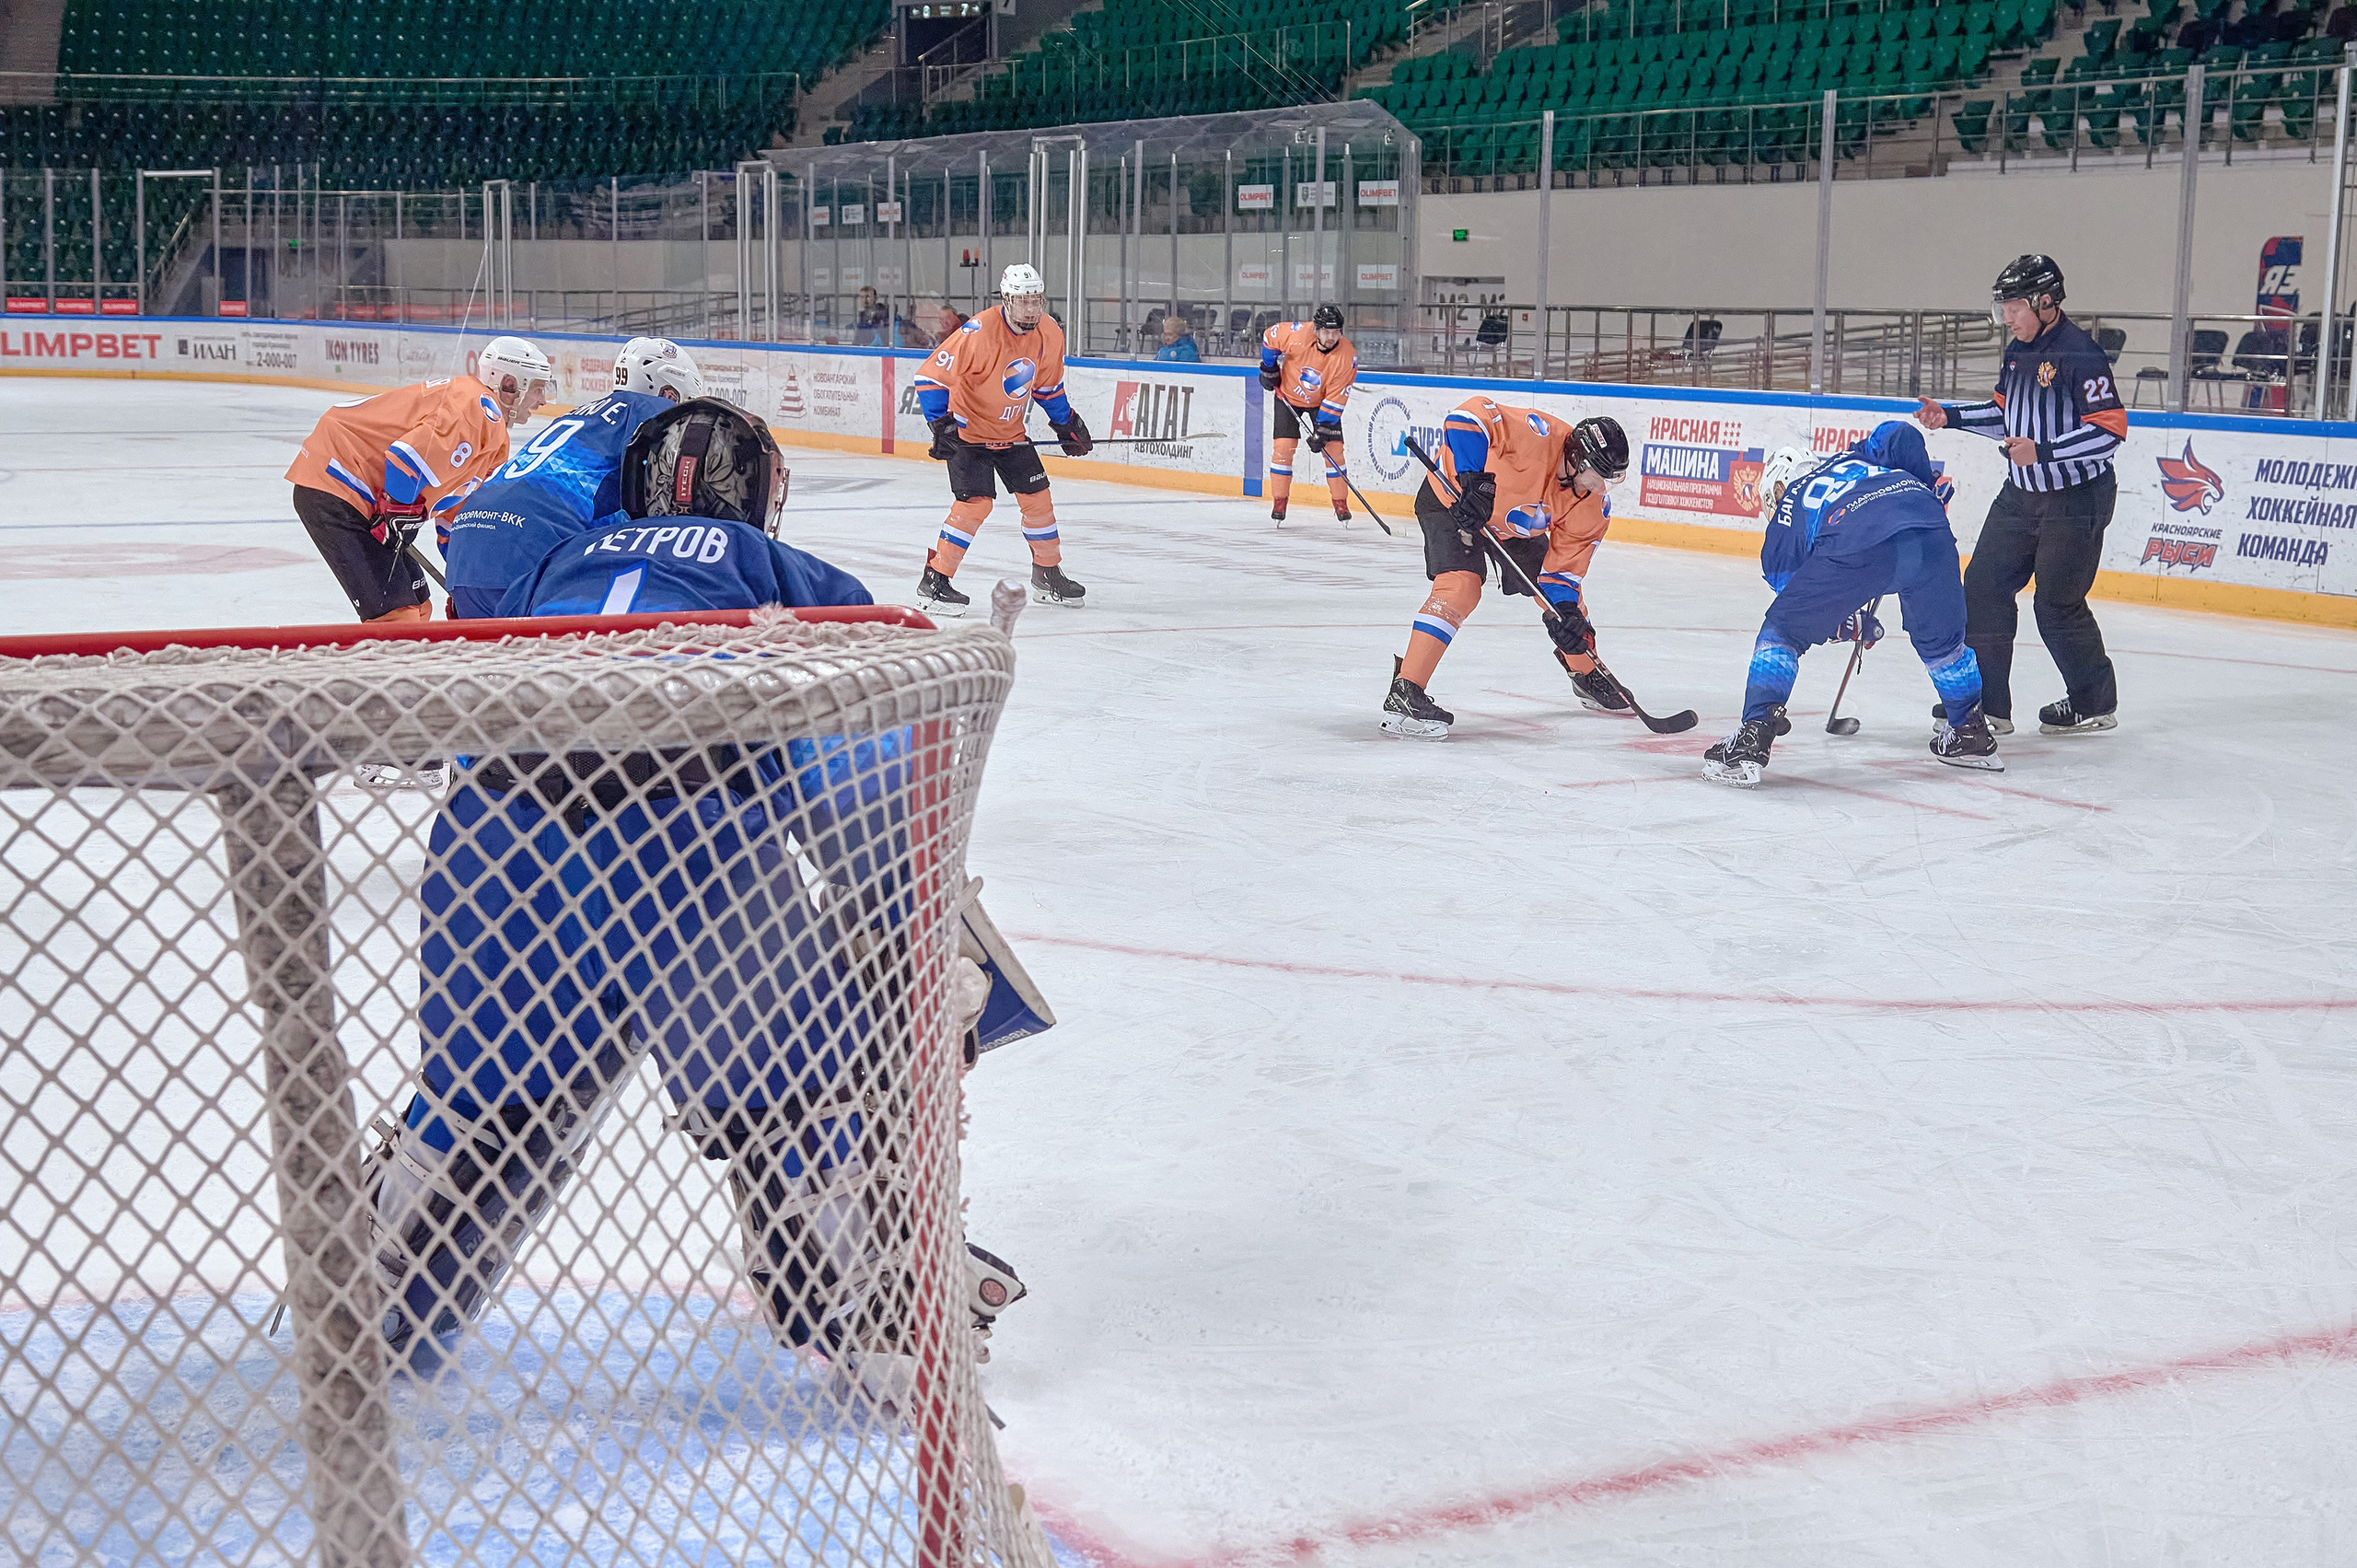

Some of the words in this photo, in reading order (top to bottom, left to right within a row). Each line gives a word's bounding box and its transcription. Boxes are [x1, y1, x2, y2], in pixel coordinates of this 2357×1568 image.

[1239, 192, 1272, 201] OLIMPBET
[1360, 189, 1397, 198] OLIMPBET
[193, 343, 237, 360] ИЛАН
[257, 352, 297, 368] 2-000-007
[325, 339, 348, 362] IKON
[350, 342, 379, 365] TYRES
[935, 350, 954, 372] 91
[615, 366, 629, 386] 99
[813, 372, 857, 385] НОВОАНГАРСКИЙ
[813, 389, 860, 401] ОБОГАТИТЕЛЬНЫЙ
[2084, 376, 2114, 403] 22
[813, 405, 842, 416] КОМБИНАТ
[1134, 382, 1194, 440] АГАТ
[1650, 416, 1721, 444] КРАСНАЯ
[450, 441, 472, 468] 8
[1134, 442, 1194, 459] АВТОХОЛДИНГ
[1645, 447, 1719, 480] МАШИНА
[1646, 478, 1689, 493] НАЦИОНАЛЬНАЯ
[1689, 482, 1723, 496] ПРОГРАММА
[2246, 495, 2357, 529] ХОККЕЙНАЯ
[2151, 521, 2223, 540] КРАСНОЯРСКИЕ
[2139, 536, 2219, 574] РЫСИ
[2235, 532, 2329, 568] КОМАНДА
